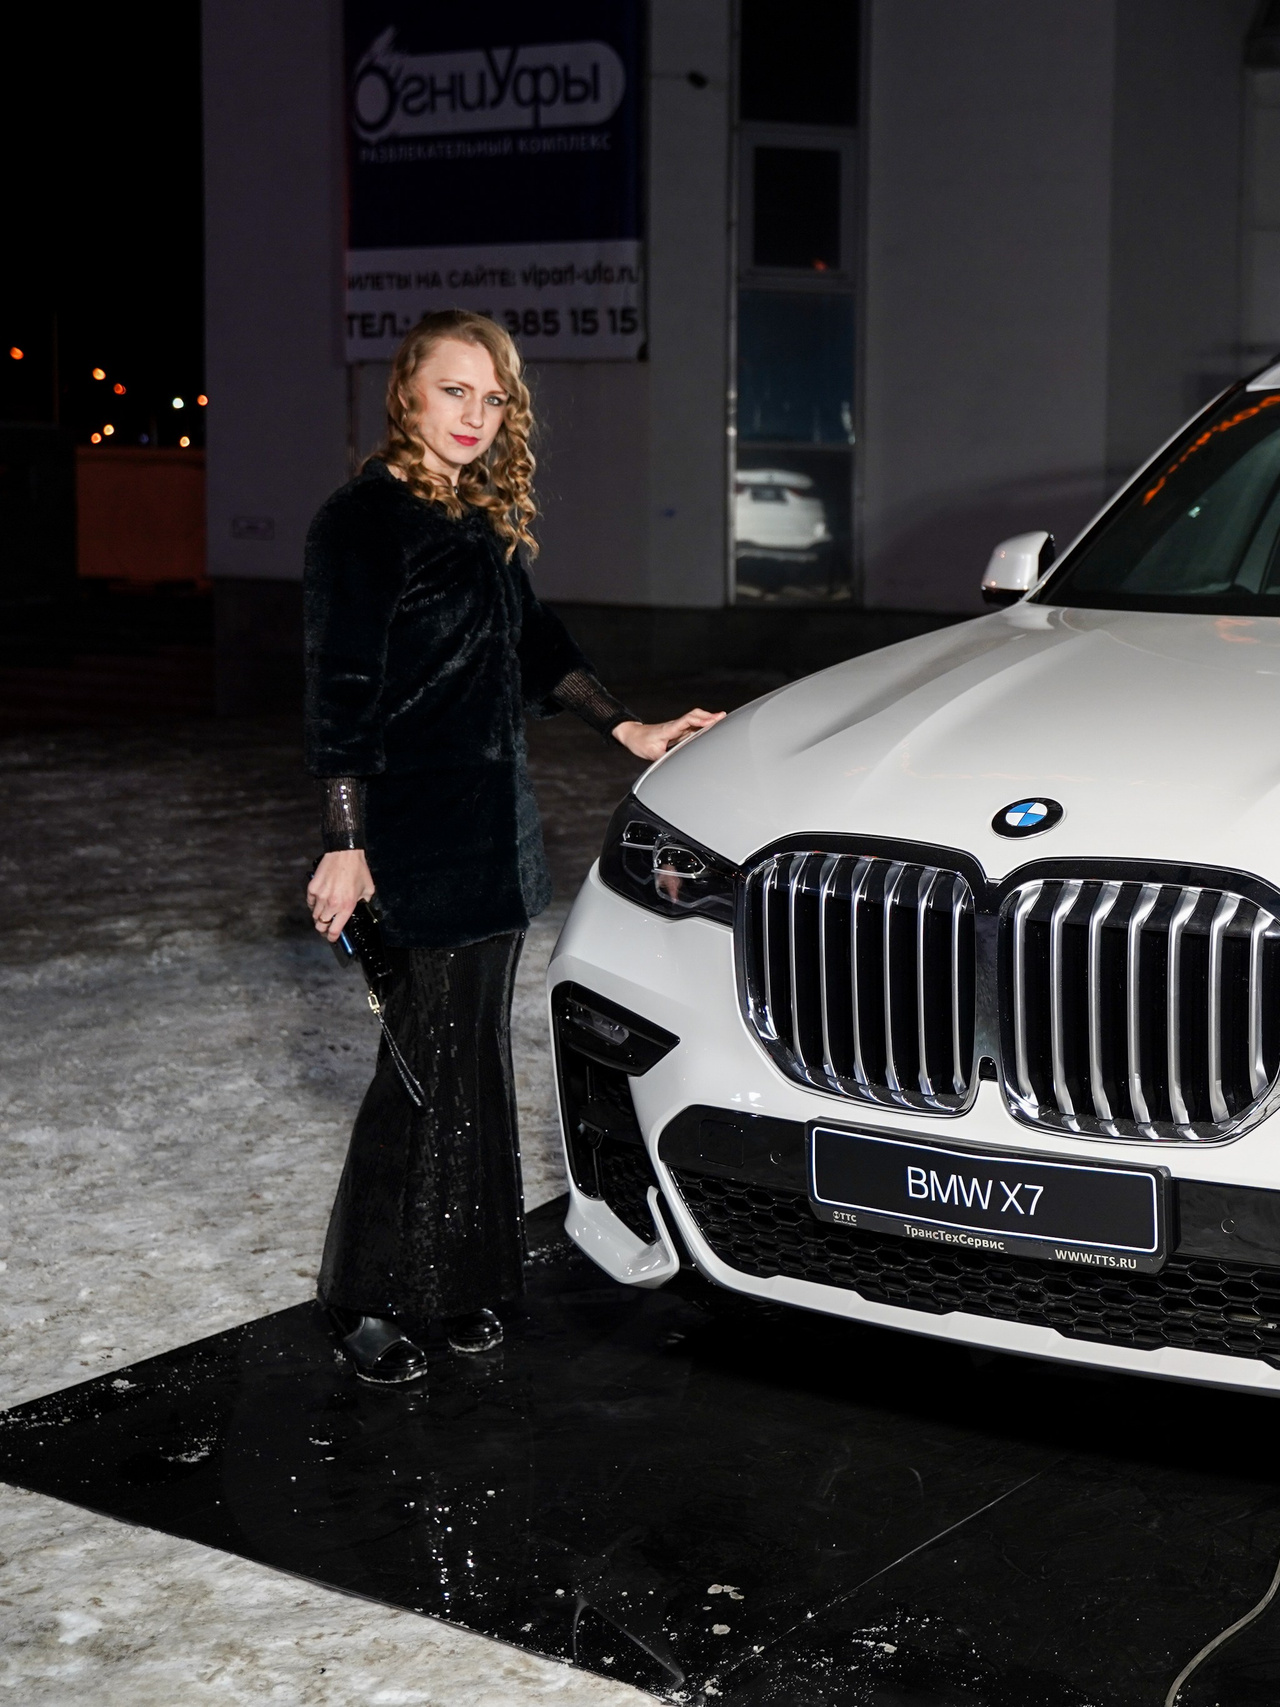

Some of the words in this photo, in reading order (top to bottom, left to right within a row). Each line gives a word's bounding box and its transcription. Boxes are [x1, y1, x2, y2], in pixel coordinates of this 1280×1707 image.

[517, 129, 612, 155] КОМПЛЕКС
[415, 270, 441, 288] НА
[447, 262, 516, 289] САЙТЕ:
[504, 307, 561, 337] 385
[570, 306, 600, 337] 15
[608, 304, 639, 336] 15
[906, 1165, 993, 1211] BMW
[1000, 1180, 1045, 1217] X7
[903, 1223, 1006, 1253] ТрансТехСервис
[1054, 1248, 1138, 1271] WWW.TTS.RU
